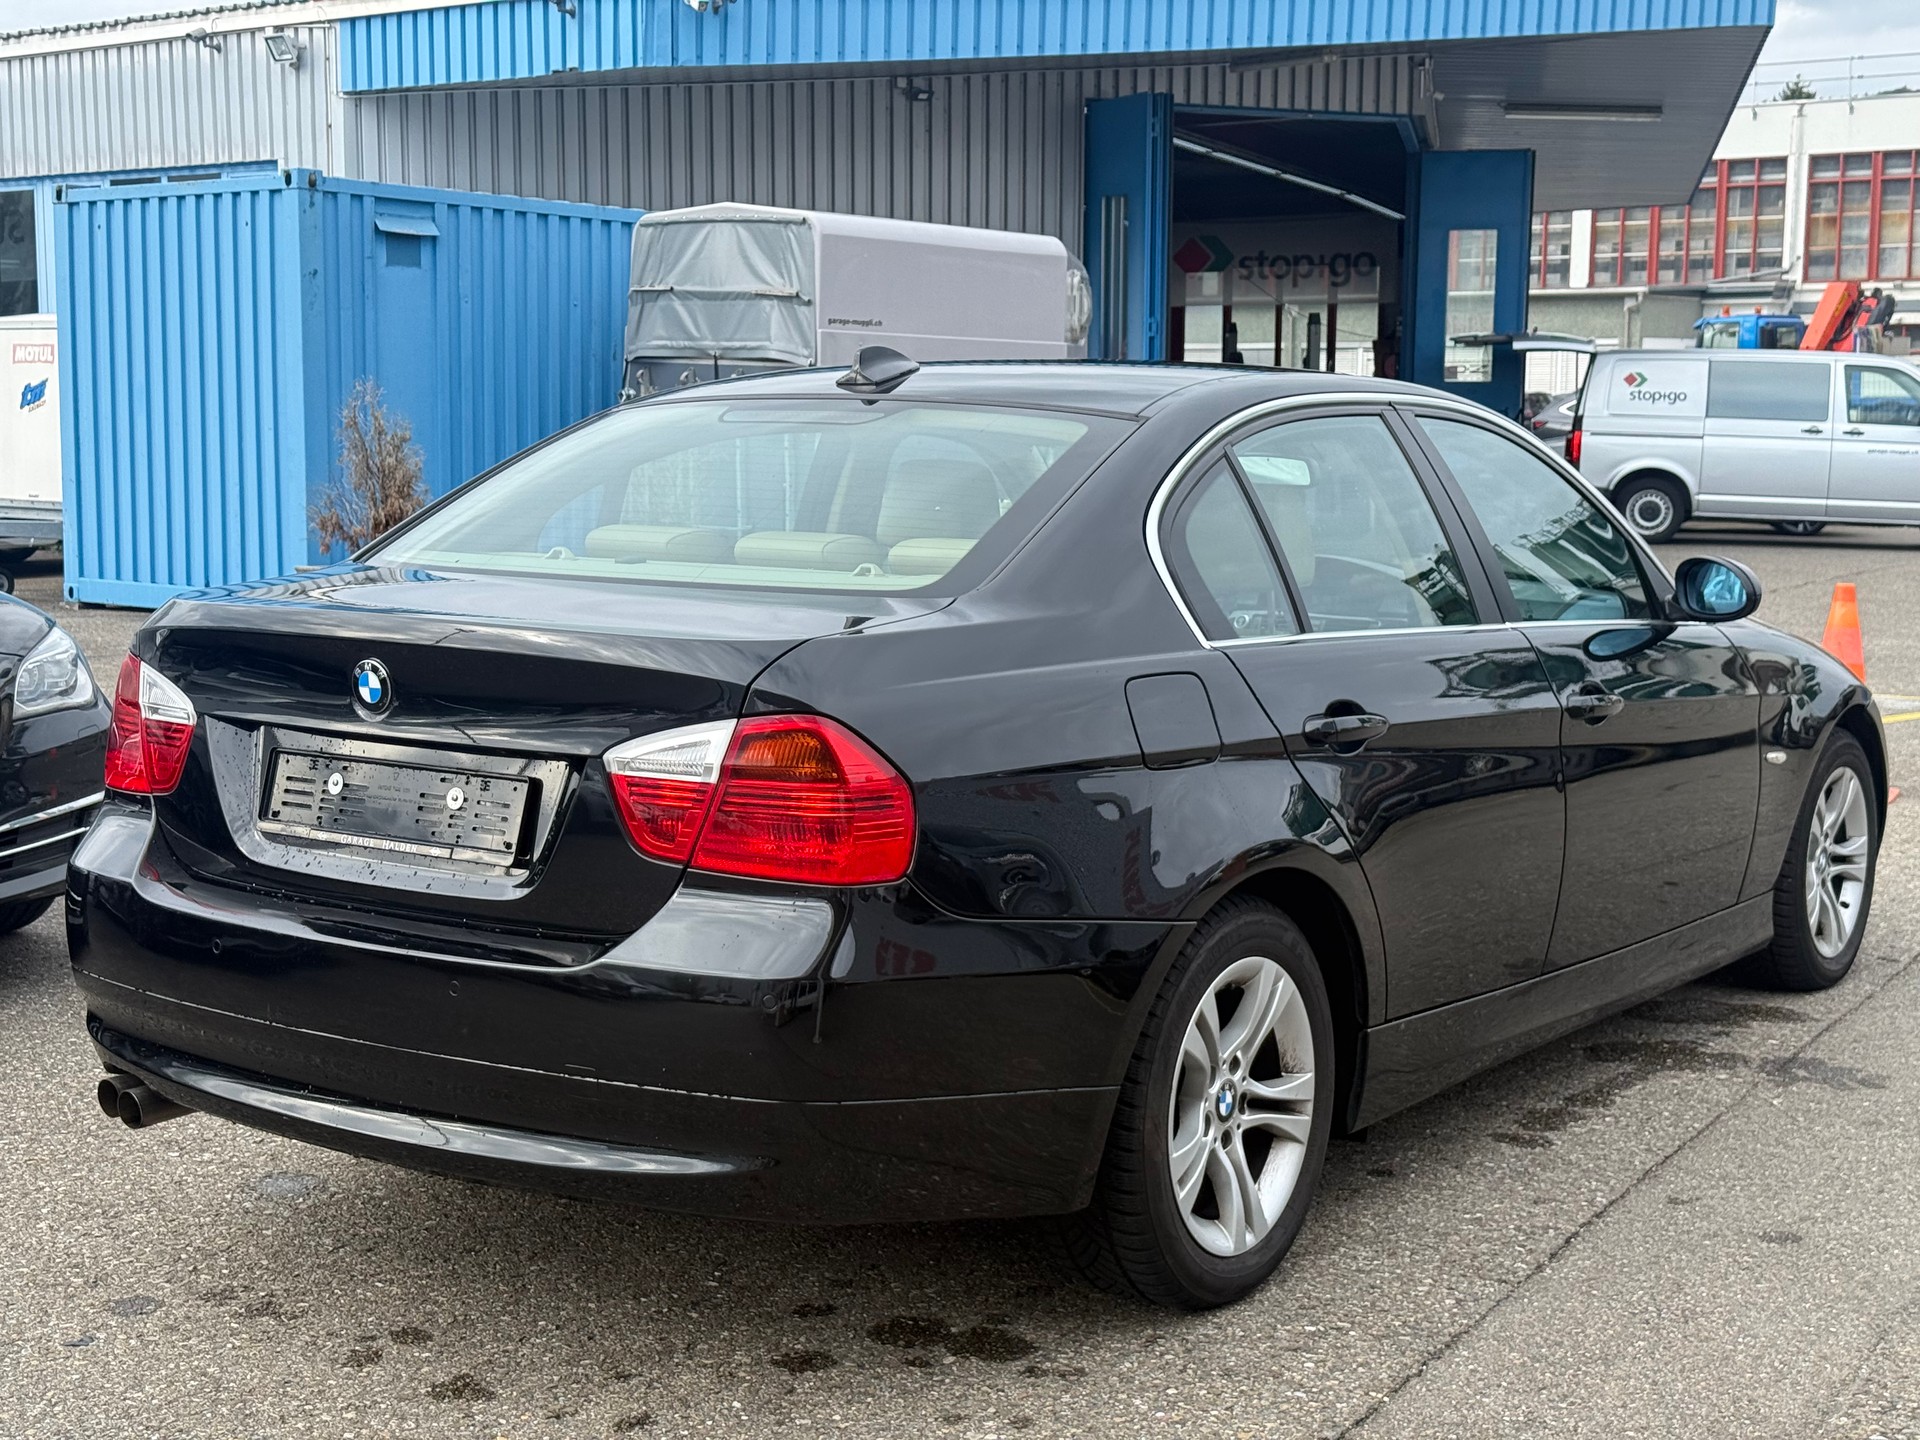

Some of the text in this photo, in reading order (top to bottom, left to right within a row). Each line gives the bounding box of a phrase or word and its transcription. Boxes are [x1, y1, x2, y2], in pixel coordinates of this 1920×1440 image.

[14, 345, 54, 363] MOTUL
[355, 662, 385, 680] BMW
[340, 835, 418, 852] GARAGE HALDEN
